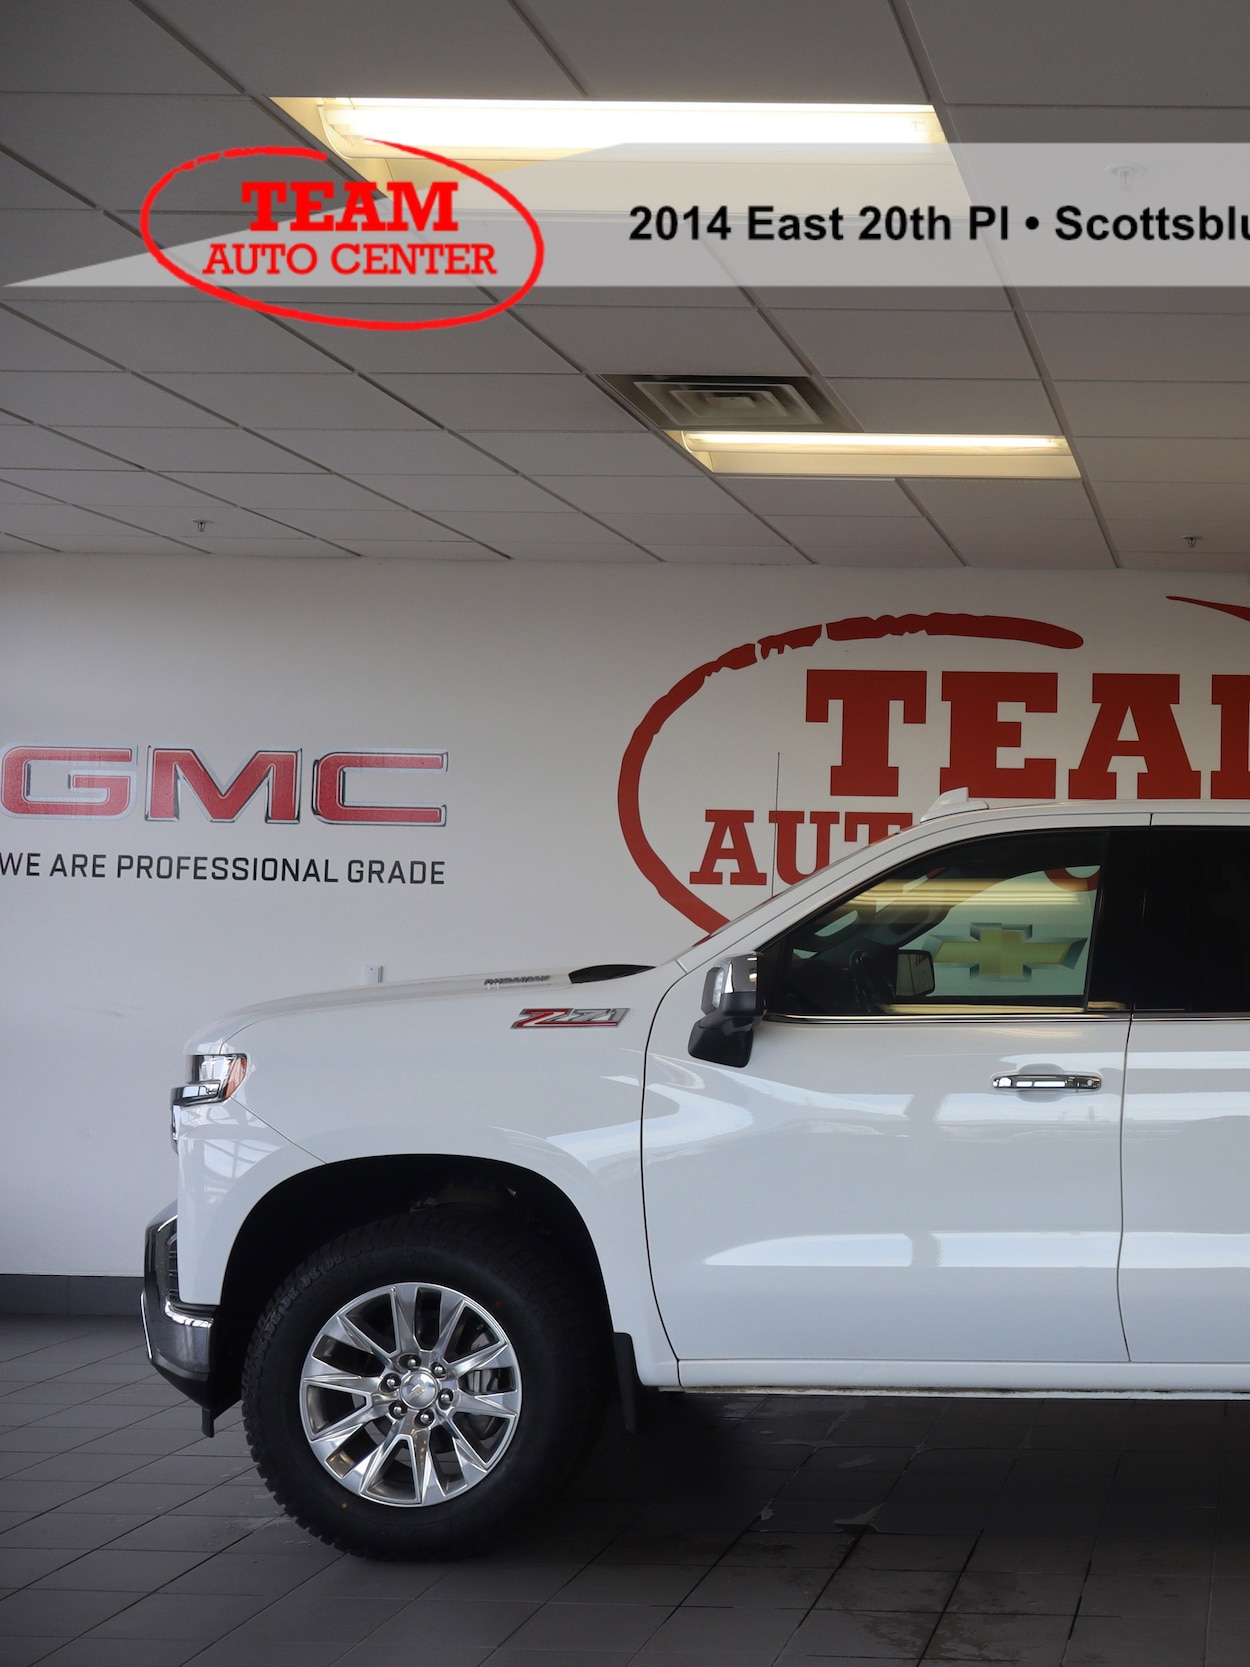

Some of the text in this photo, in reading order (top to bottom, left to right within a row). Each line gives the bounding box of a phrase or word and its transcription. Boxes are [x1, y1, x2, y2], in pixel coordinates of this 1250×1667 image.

[1, 744, 448, 827] GMC
[0, 852, 446, 885] WE ARE PROFESSIONAL GRADE
[510, 1007, 631, 1029] Z71
